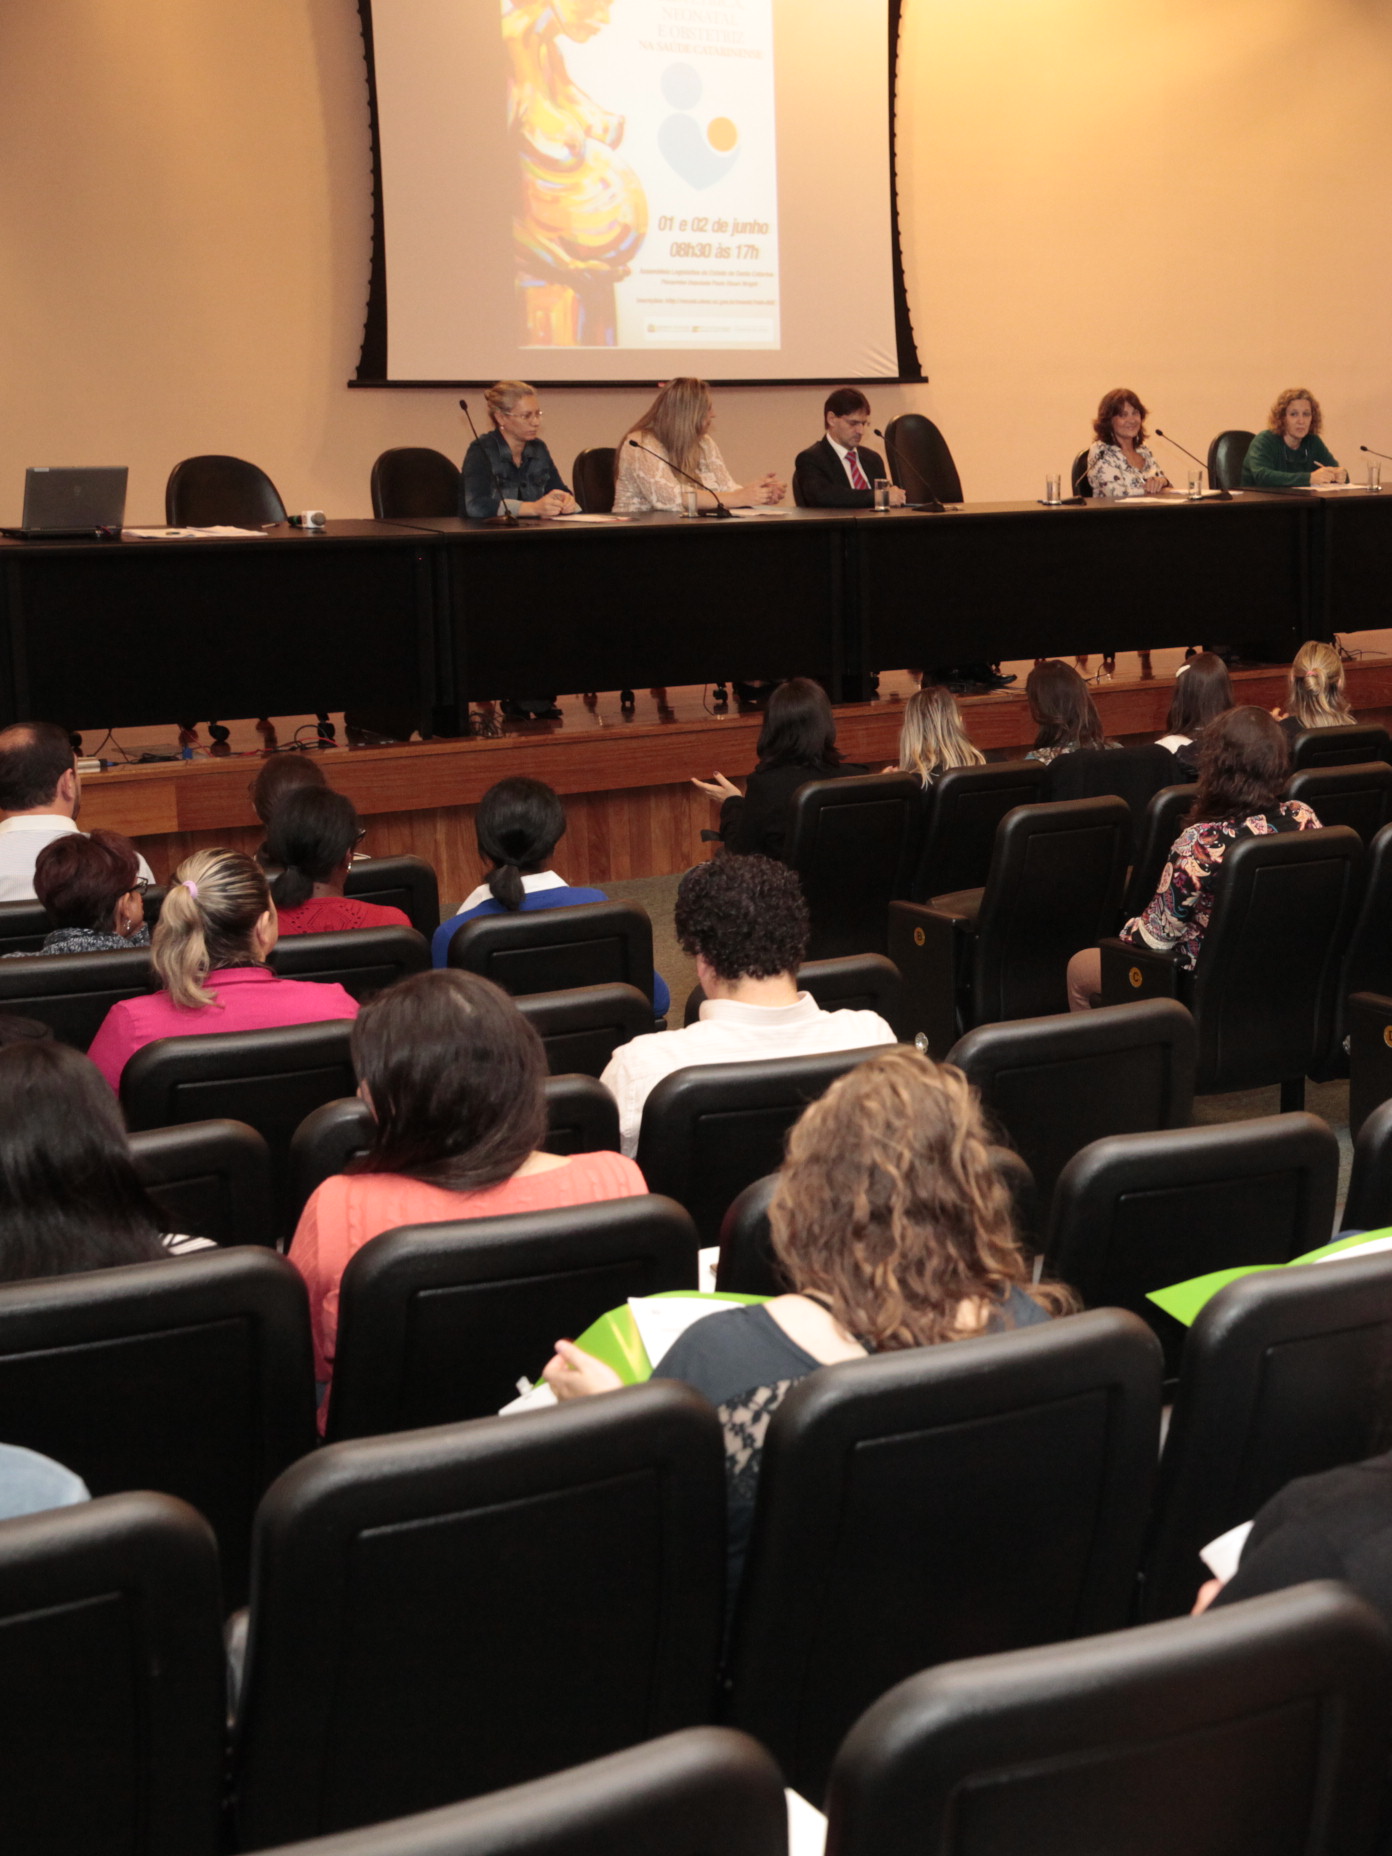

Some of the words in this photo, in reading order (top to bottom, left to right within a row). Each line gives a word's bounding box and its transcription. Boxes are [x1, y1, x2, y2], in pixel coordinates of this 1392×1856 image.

[658, 215, 674, 232] 01
[678, 219, 688, 232] e
[691, 217, 709, 233] 02
[712, 218, 728, 233] de
[730, 218, 769, 236] junho
[670, 242, 712, 258] 08h30
[715, 243, 731, 259] às
[735, 244, 759, 260] 17h
